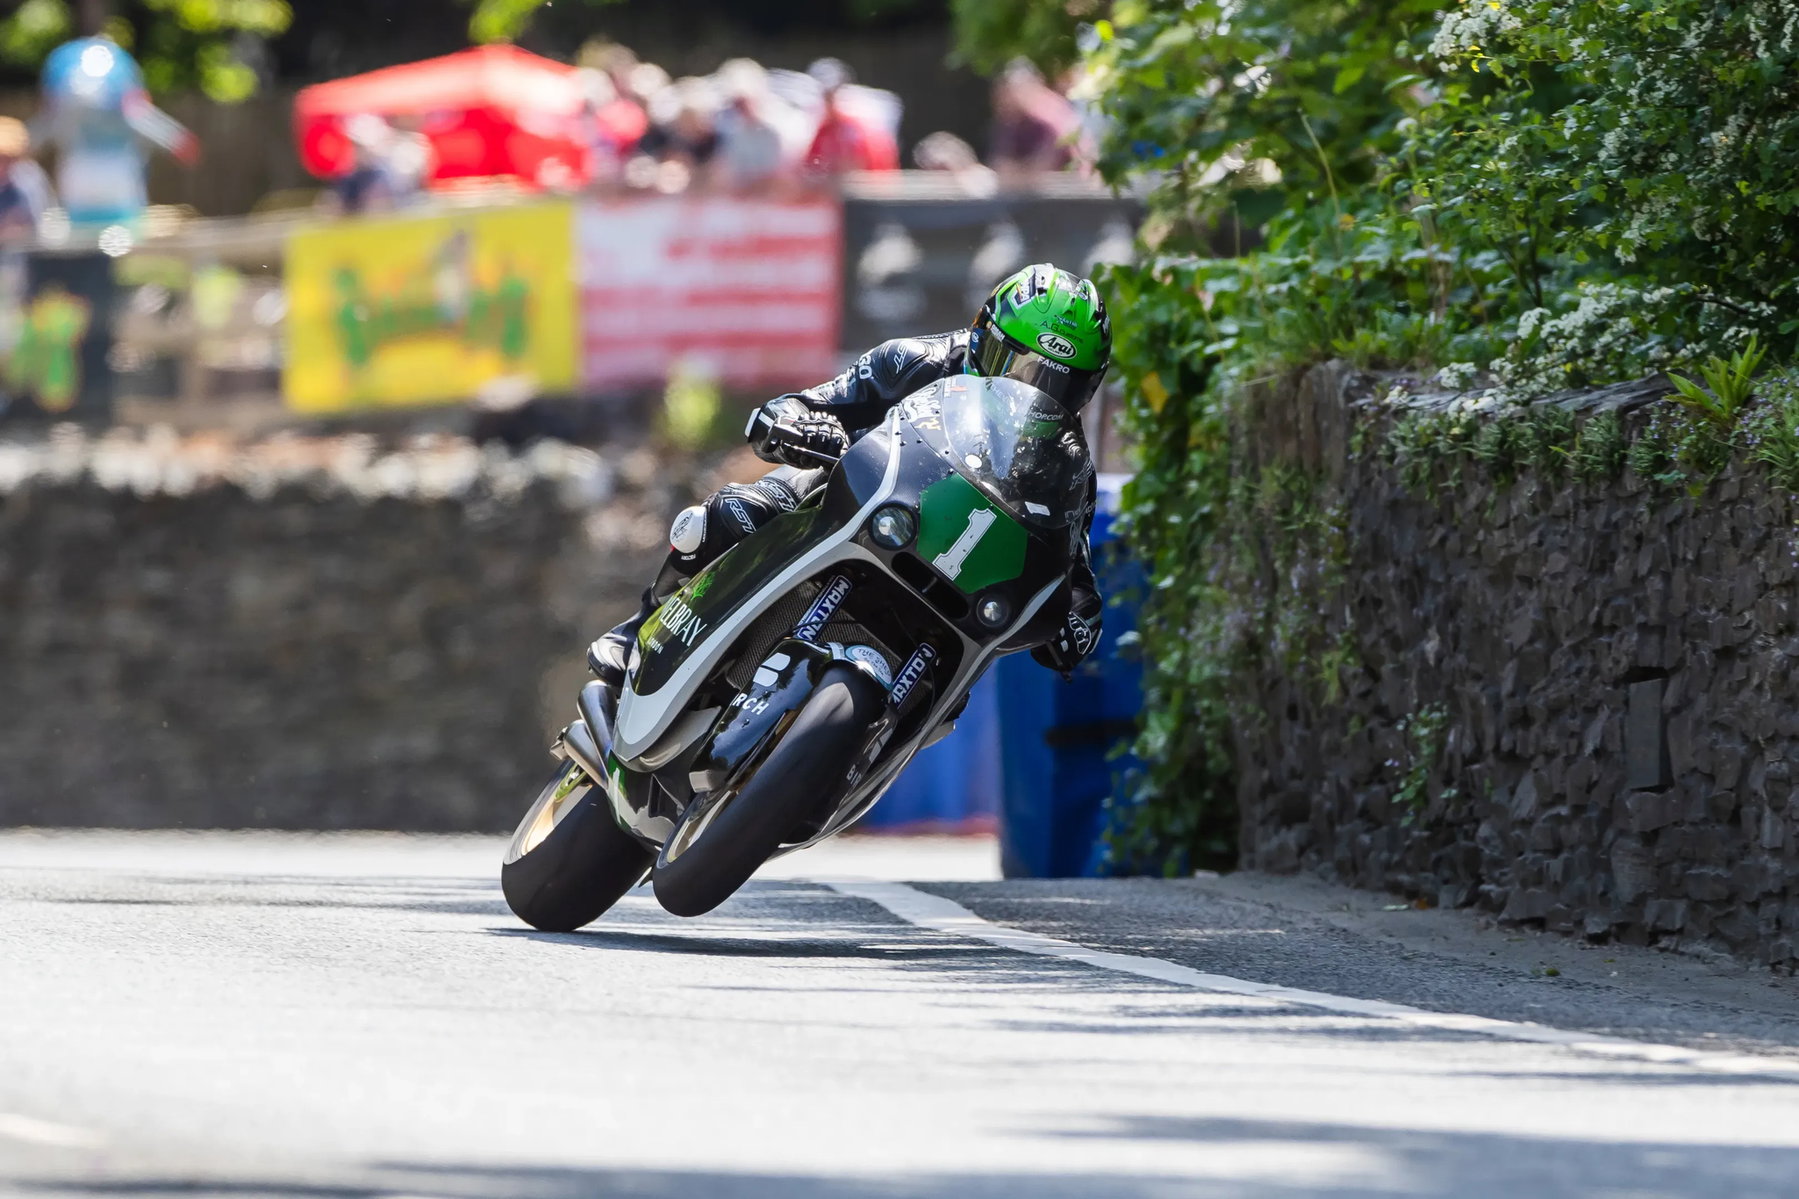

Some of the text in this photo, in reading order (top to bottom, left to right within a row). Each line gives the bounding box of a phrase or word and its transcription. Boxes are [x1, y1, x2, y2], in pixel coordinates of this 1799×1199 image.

[1037, 355, 1070, 374] FAKRO
[1040, 336, 1072, 354] Arai
[932, 508, 997, 581] 1
[801, 579, 850, 641] MAXTON
